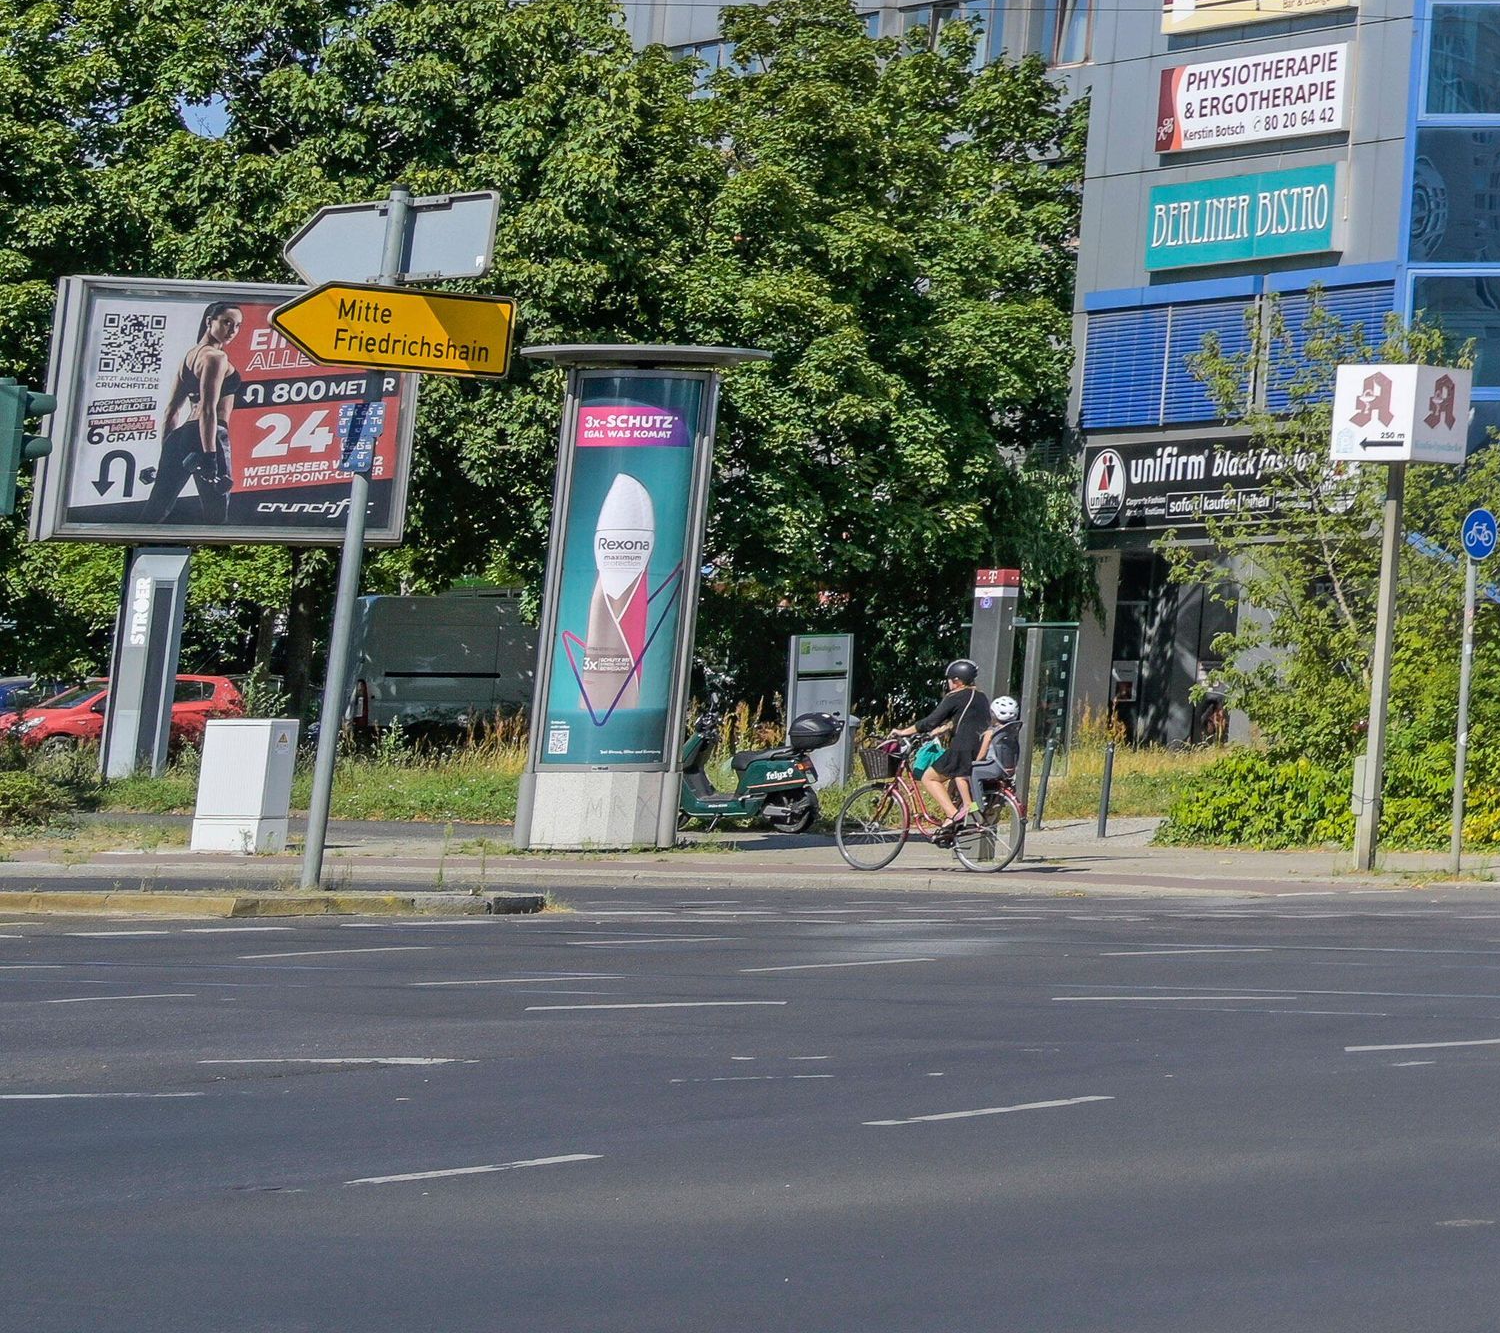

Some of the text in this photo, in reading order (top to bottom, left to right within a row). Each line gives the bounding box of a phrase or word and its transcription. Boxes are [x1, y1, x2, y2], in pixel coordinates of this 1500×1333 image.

[1186, 51, 1338, 93] PHYSIOTHERAPIE
[1184, 80, 1336, 119] & ERGOTHERAPIE
[1183, 107, 1334, 141] Kerstin Botsch 80 20 64 42
[1151, 184, 1328, 248] BERLINER BISTRO
[338, 298, 392, 324] Mitte
[333, 329, 489, 363] Friedrichshain
[95, 382, 160, 390] CRUNCHFIT.DE
[272, 377, 396, 403] 800 METR
[87, 426, 106, 446] 6
[106, 429, 157, 444] GRATIS
[251, 410, 334, 458] 24
[584, 430, 672, 439] EGAL WAS KOMMT
[1130, 446, 1208, 484] unifirm
[1212, 448, 1255, 477] black
[243, 472, 257, 486] IM
[257, 498, 374, 518] crunchf
[598, 537, 650, 551] Rexona
[583, 657, 598, 671] 3x
[766, 770, 788, 781] felyx
